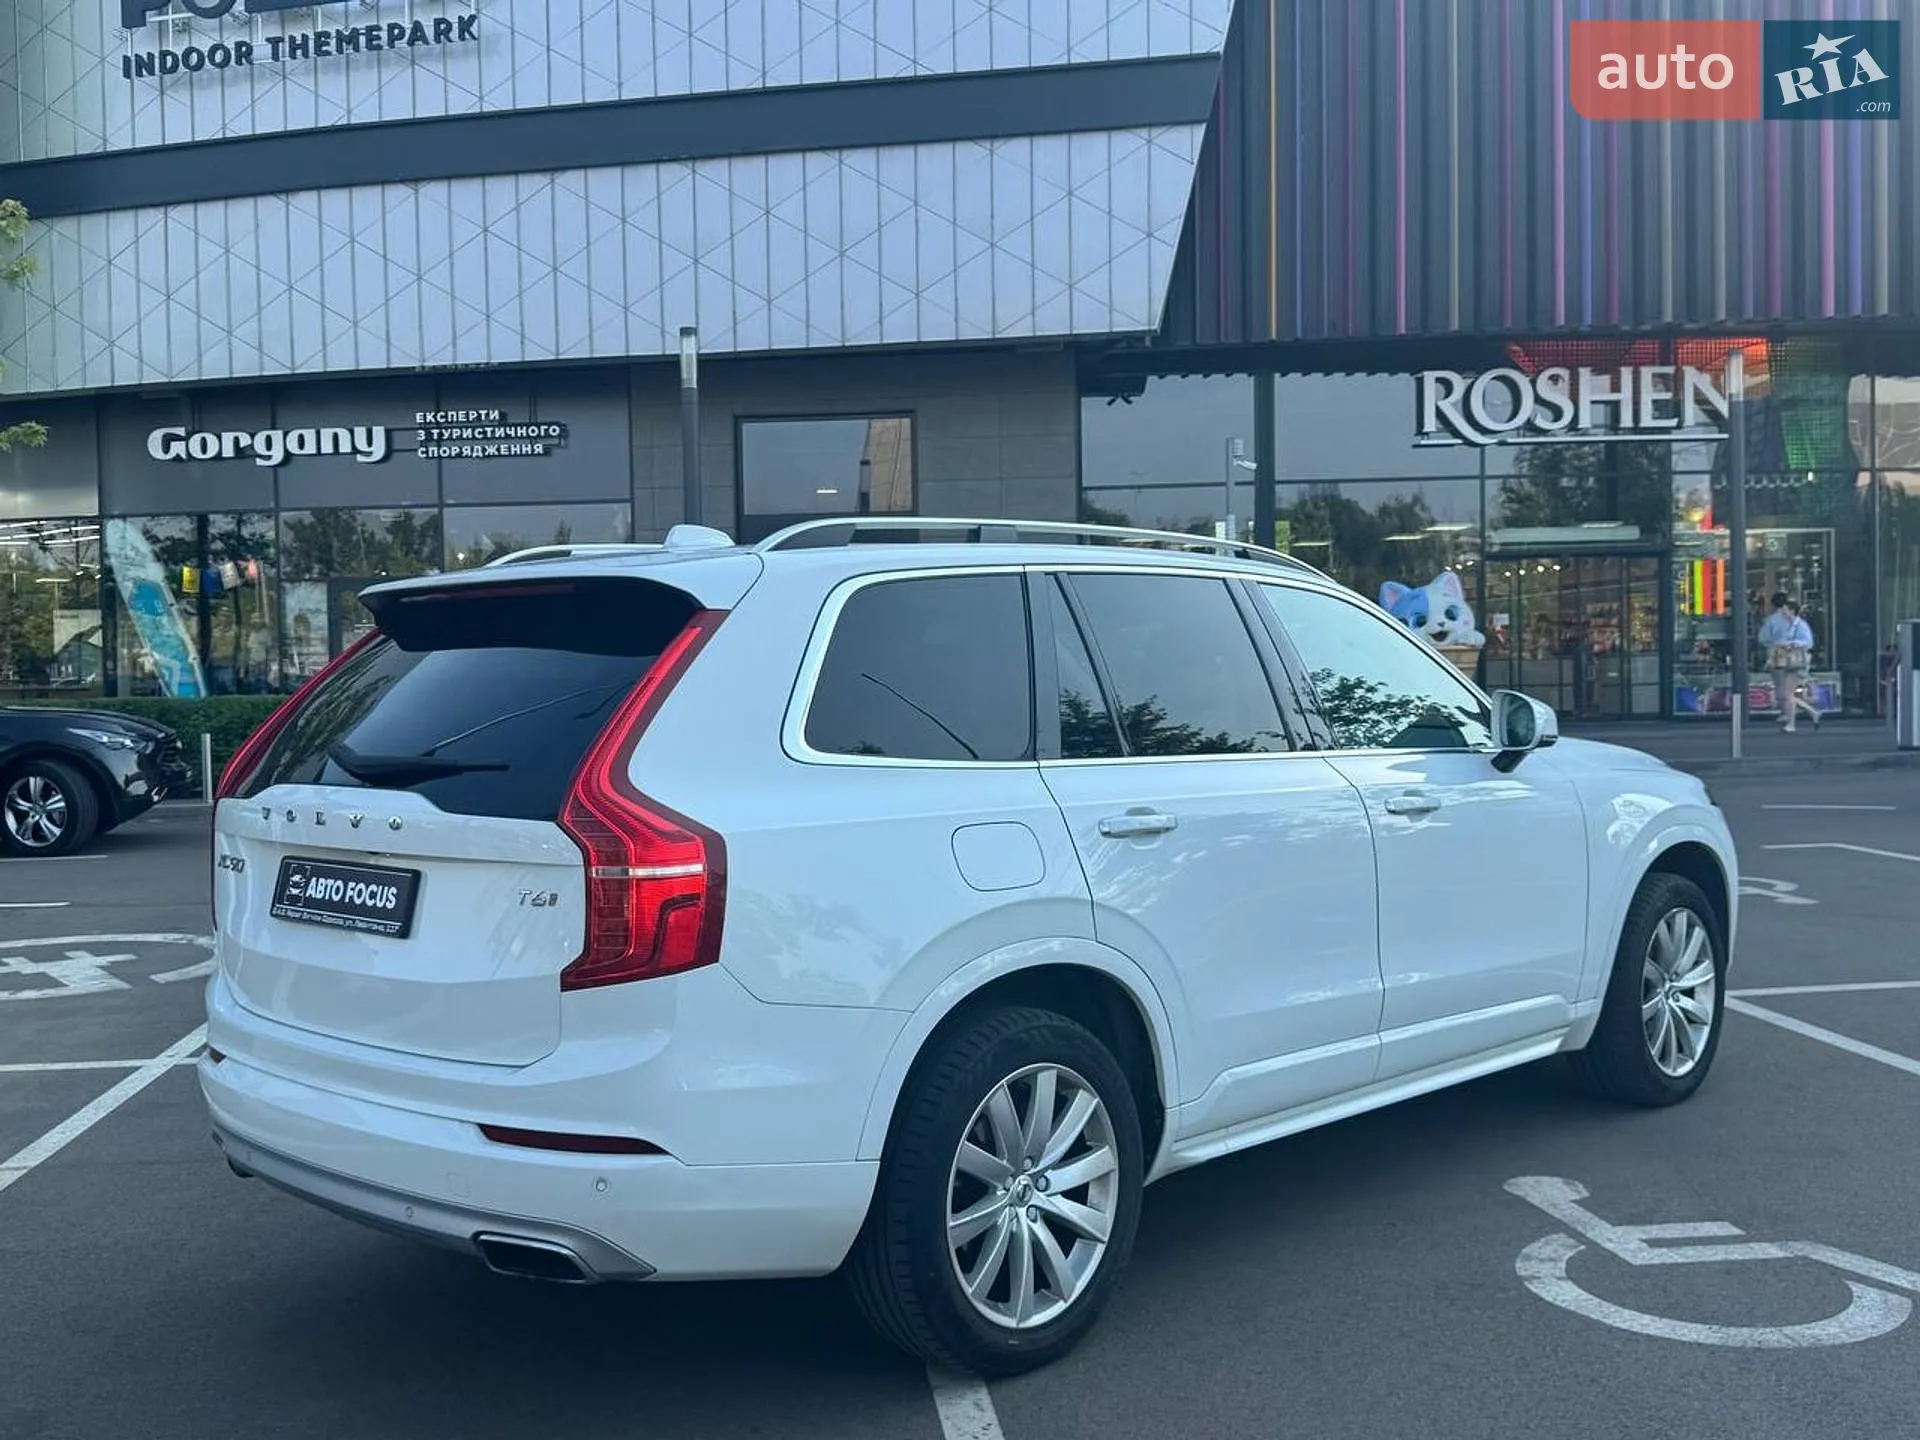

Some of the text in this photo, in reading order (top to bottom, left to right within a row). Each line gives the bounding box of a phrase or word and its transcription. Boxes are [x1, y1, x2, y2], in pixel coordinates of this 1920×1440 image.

[122, 40, 253, 80] INDOOR
[265, 14, 479, 62] THEMEPARK
[415, 409, 500, 424] ЕКСПЕРТИ
[1420, 365, 1729, 445] ROSHEN
[146, 425, 386, 467] Gorgany
[431, 425, 561, 439] ТУРИСТИЧНОГО
[417, 443, 544, 458] СПОРЯДЖЕННЯ
[261, 805, 403, 832] VOLVO
[344, 881, 398, 910] FOCUS
